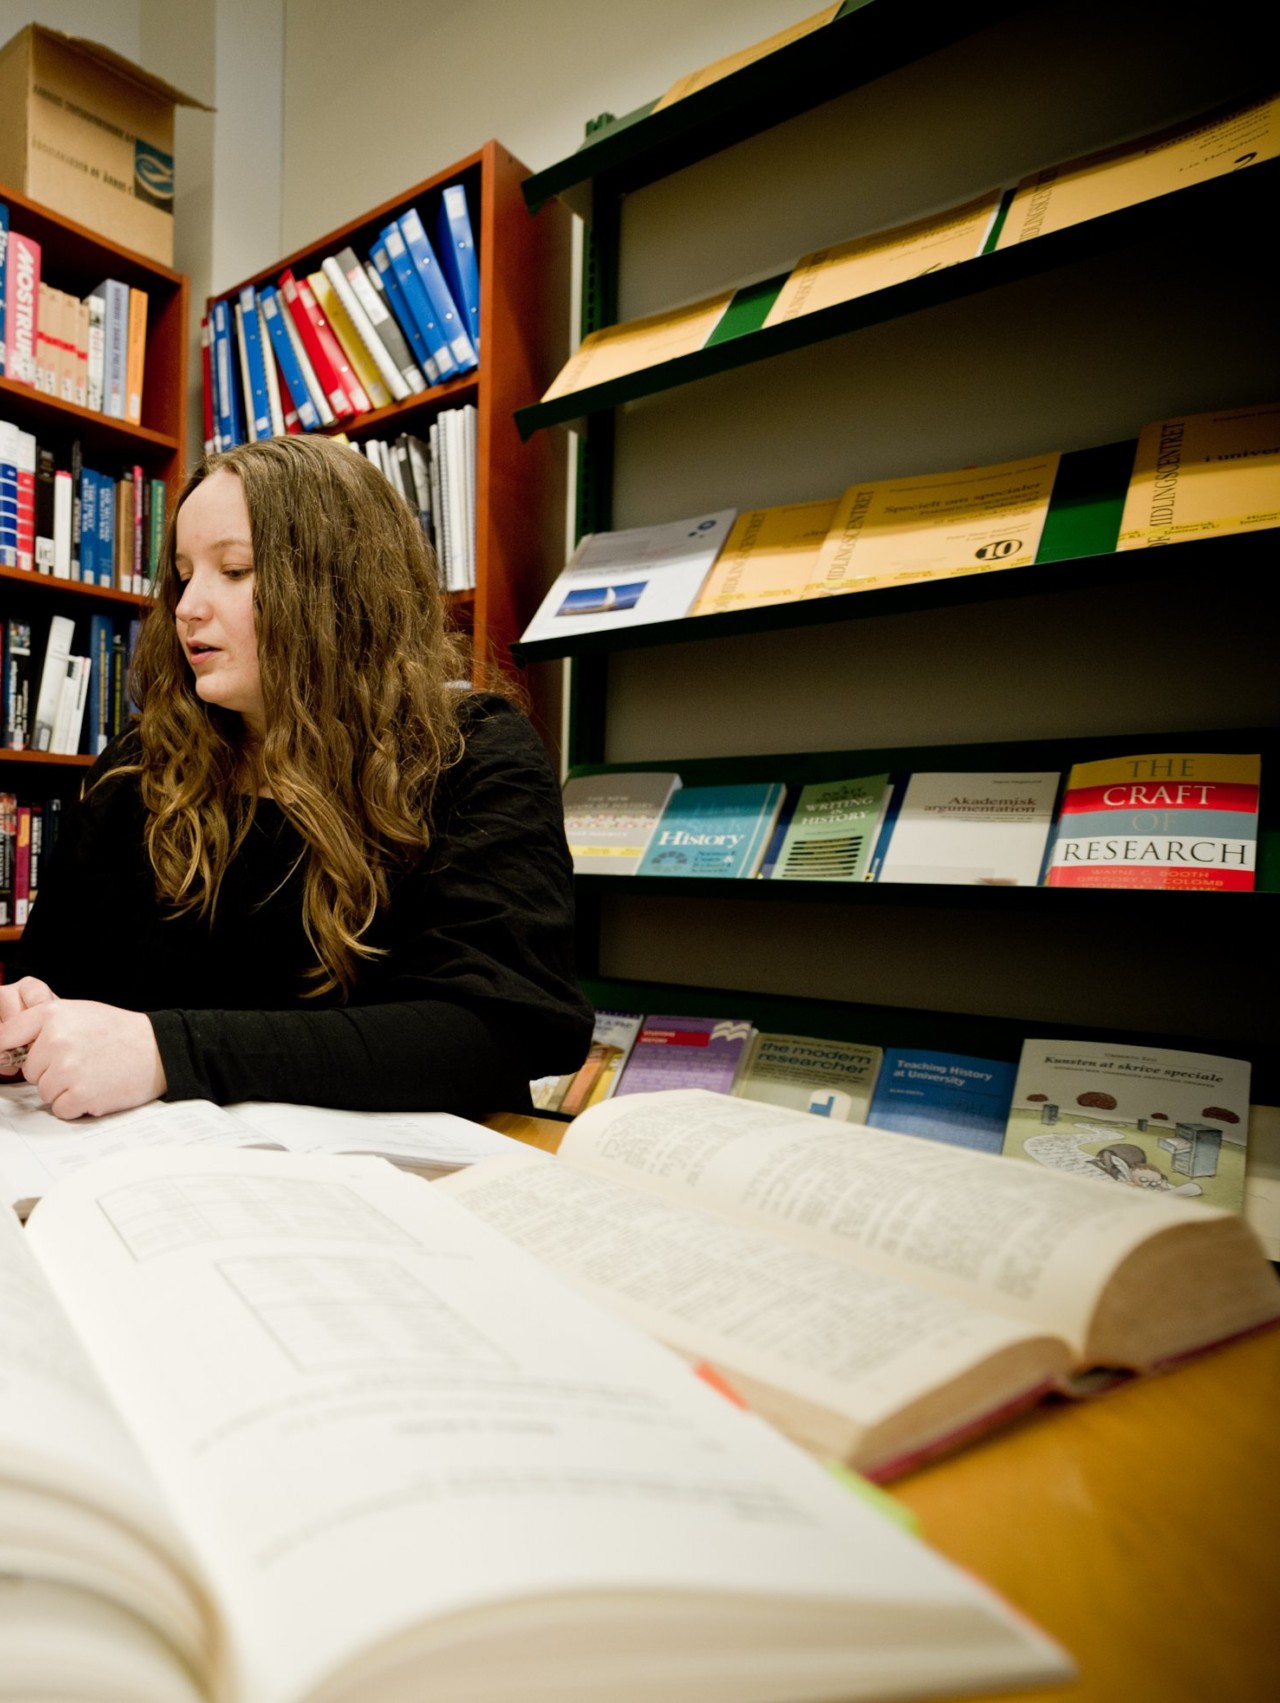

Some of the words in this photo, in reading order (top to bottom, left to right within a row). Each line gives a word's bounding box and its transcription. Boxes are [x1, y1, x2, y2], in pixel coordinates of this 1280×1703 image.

[884, 498, 942, 514] Specielt
[973, 481, 1041, 501] specialer
[980, 540, 1022, 560] 10
[1126, 758, 1196, 779] THE
[805, 796, 875, 812] WRITING
[948, 797, 1038, 807] Akademisk
[1102, 785, 1216, 807] CRAFT
[801, 810, 869, 825] HISTORY
[923, 804, 1036, 814] argumentation
[1131, 812, 1179, 832] OF
[657, 830, 746, 849] History
[1062, 840, 1248, 865] RESEARCH
[1159, 870, 1210, 879] BOOTH
[1164, 878, 1225, 887] COLOMB
[758, 1052, 870, 1075] researcher
[761, 1042, 789, 1054] the
[792, 1046, 872, 1065] modern
[897, 1060, 948, 1075] Teaching
[949, 1066, 994, 1082] History
[907, 1070, 967, 1087] University
[1044, 1056, 1098, 1068] Kunsten
[1117, 1063, 1163, 1076] skrive
[1164, 1069, 1225, 1083] speciale
